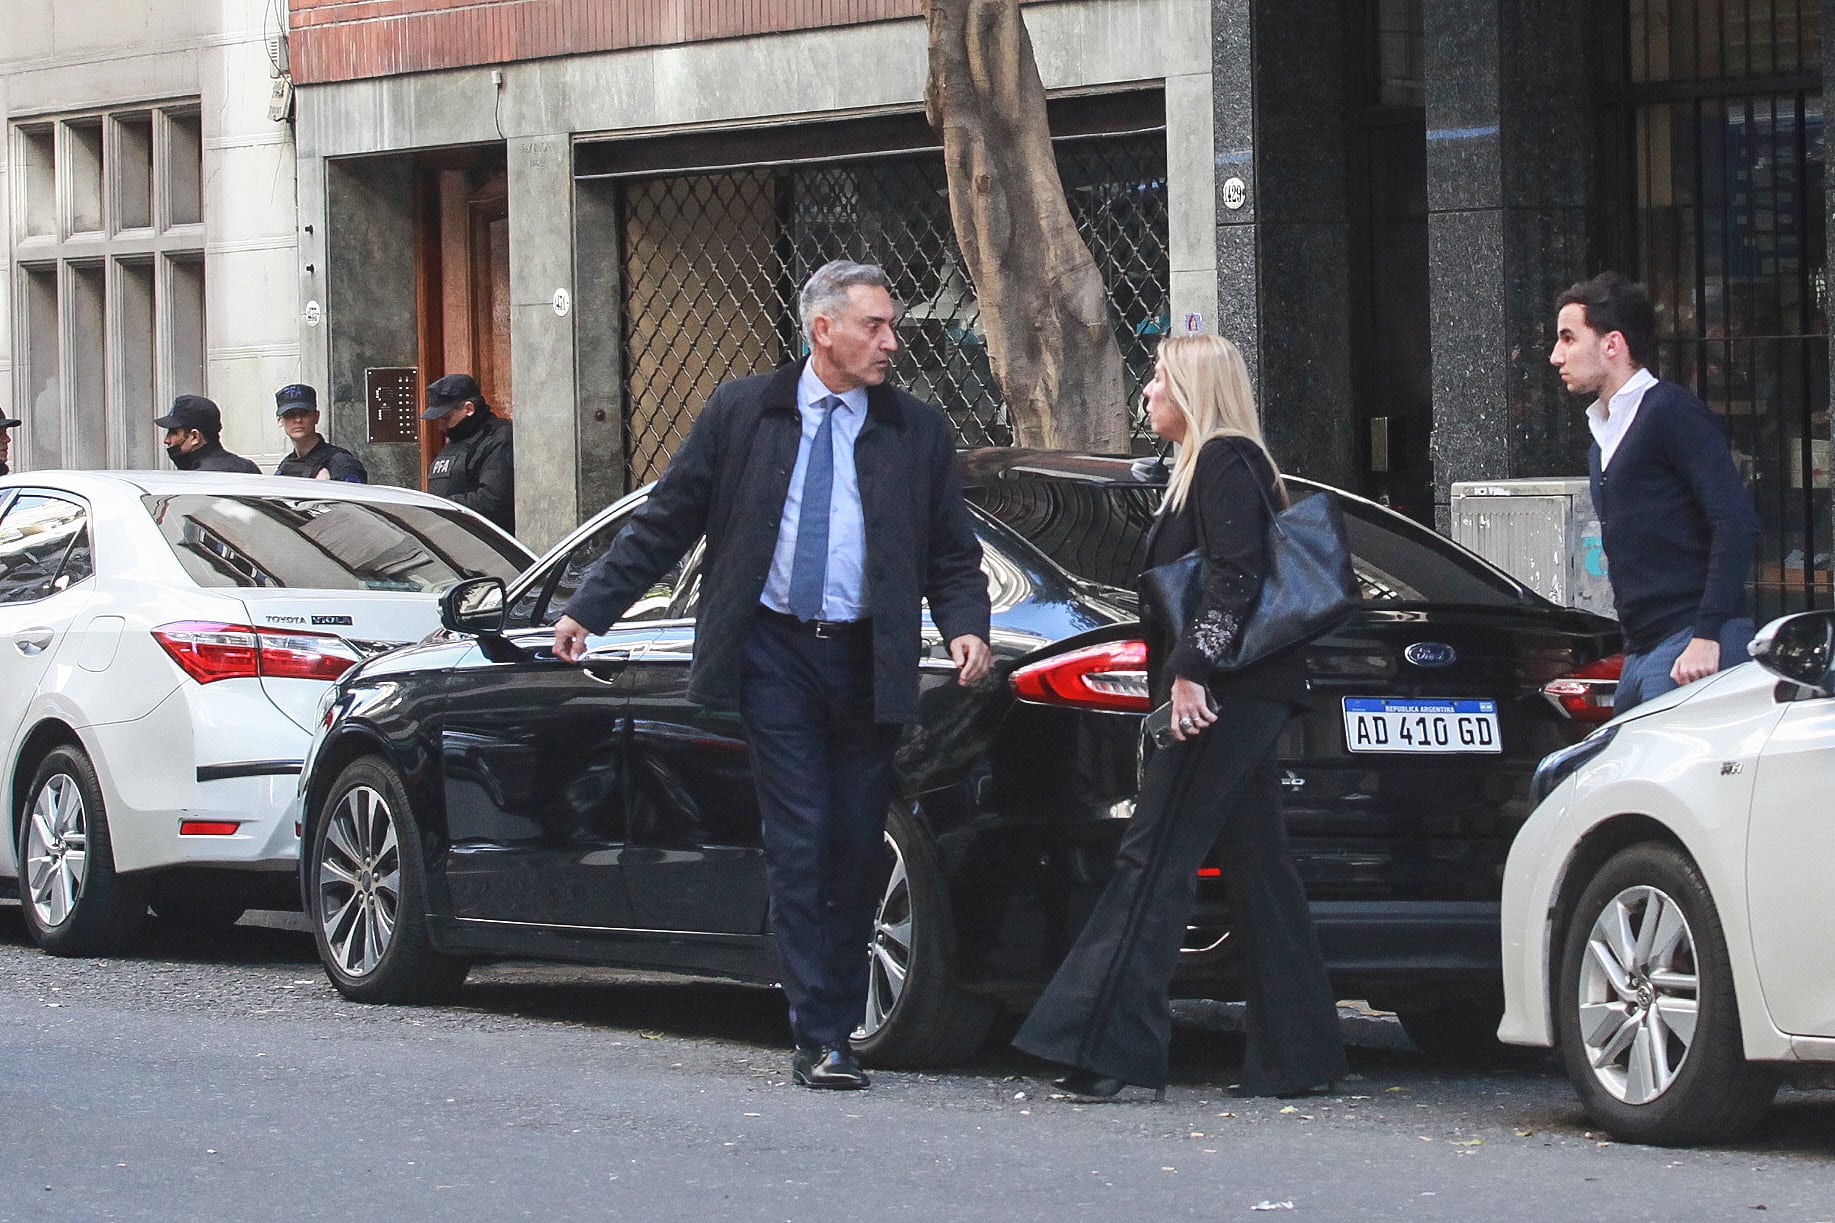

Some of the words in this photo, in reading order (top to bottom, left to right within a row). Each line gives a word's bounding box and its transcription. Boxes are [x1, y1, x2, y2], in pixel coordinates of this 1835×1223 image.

[1224, 184, 1242, 203] 1429
[432, 459, 450, 474] PFA
[265, 615, 307, 624] TOYOTA
[1357, 715, 1389, 745] AD
[1400, 716, 1449, 746] 410
[1458, 717, 1493, 746] GD
